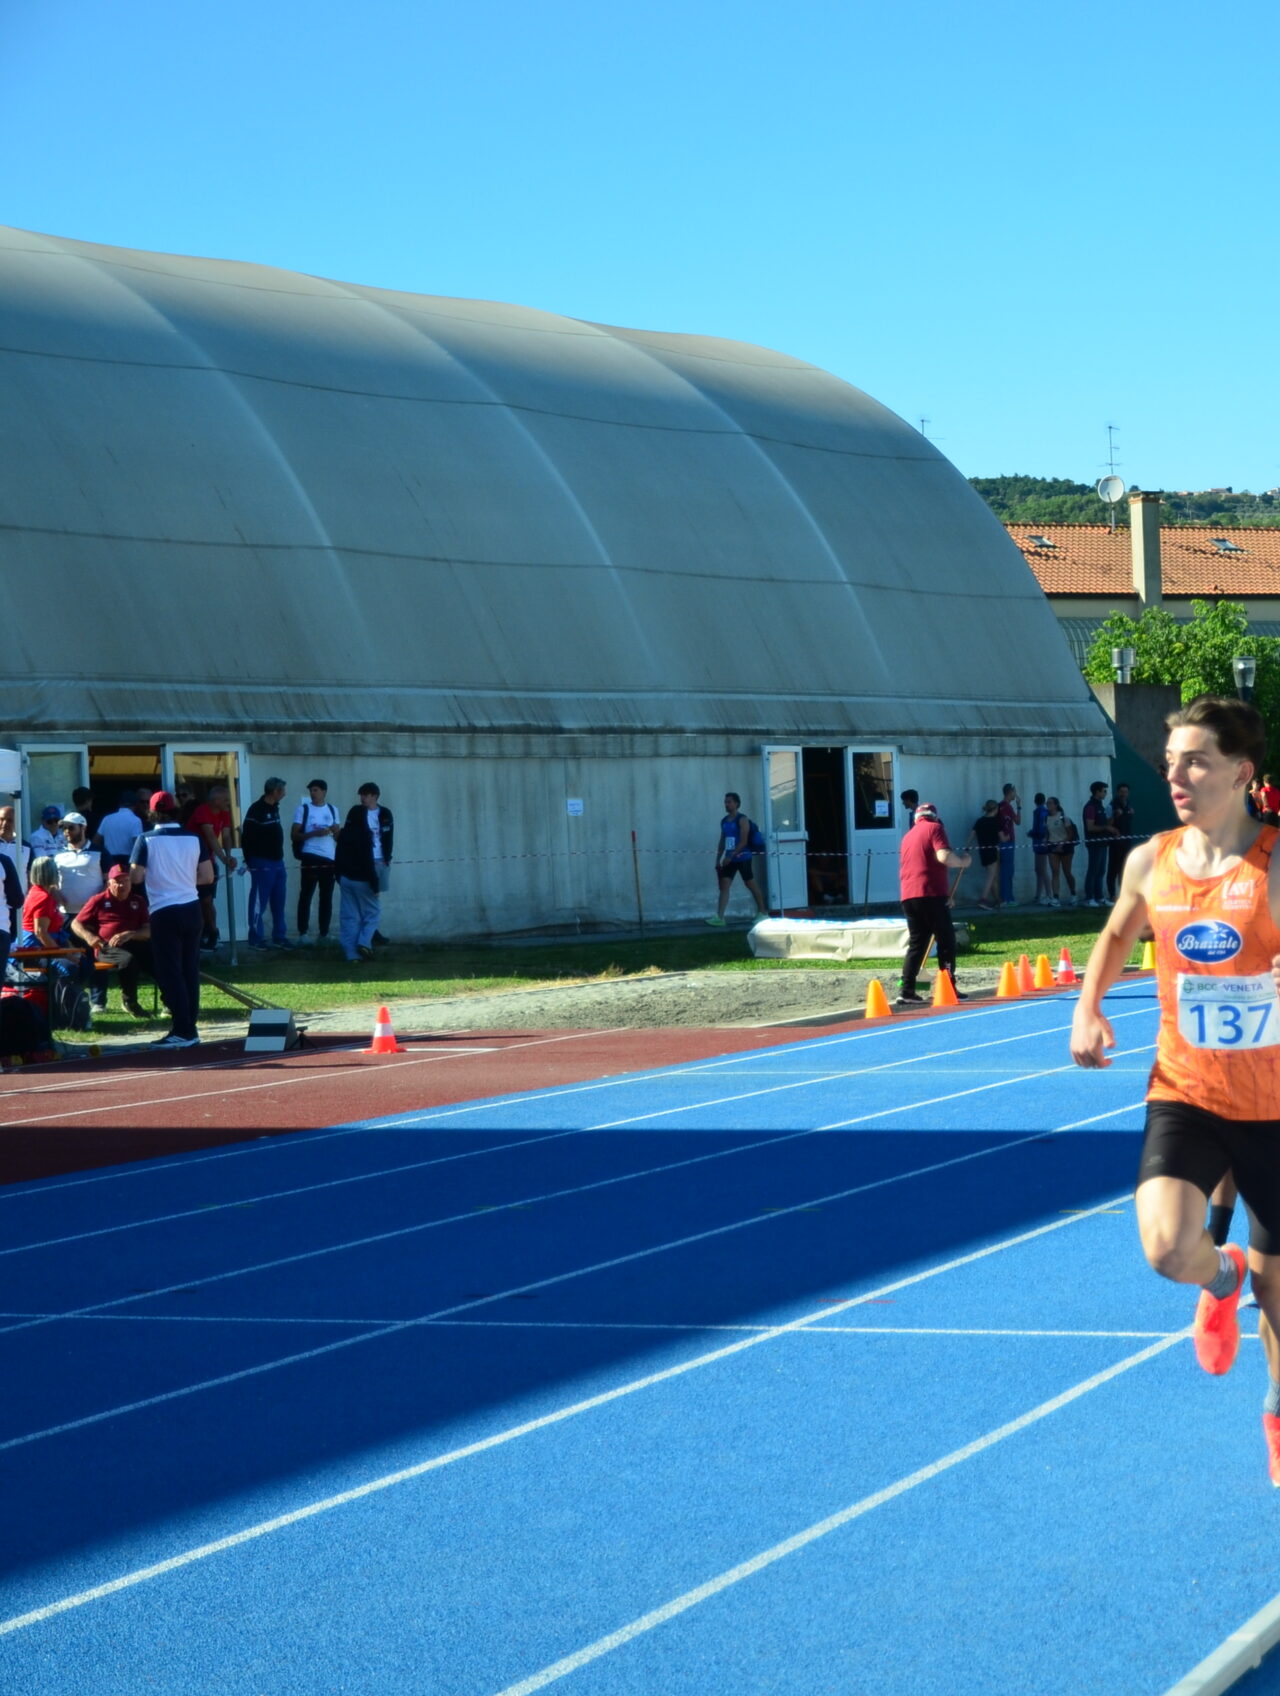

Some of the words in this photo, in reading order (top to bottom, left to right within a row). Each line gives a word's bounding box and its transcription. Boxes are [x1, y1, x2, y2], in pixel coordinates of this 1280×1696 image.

[1179, 934, 1238, 950] Brazzale
[1197, 983, 1218, 991] BCC
[1223, 983, 1263, 993] VENETA
[1189, 1002, 1273, 1045] 137
